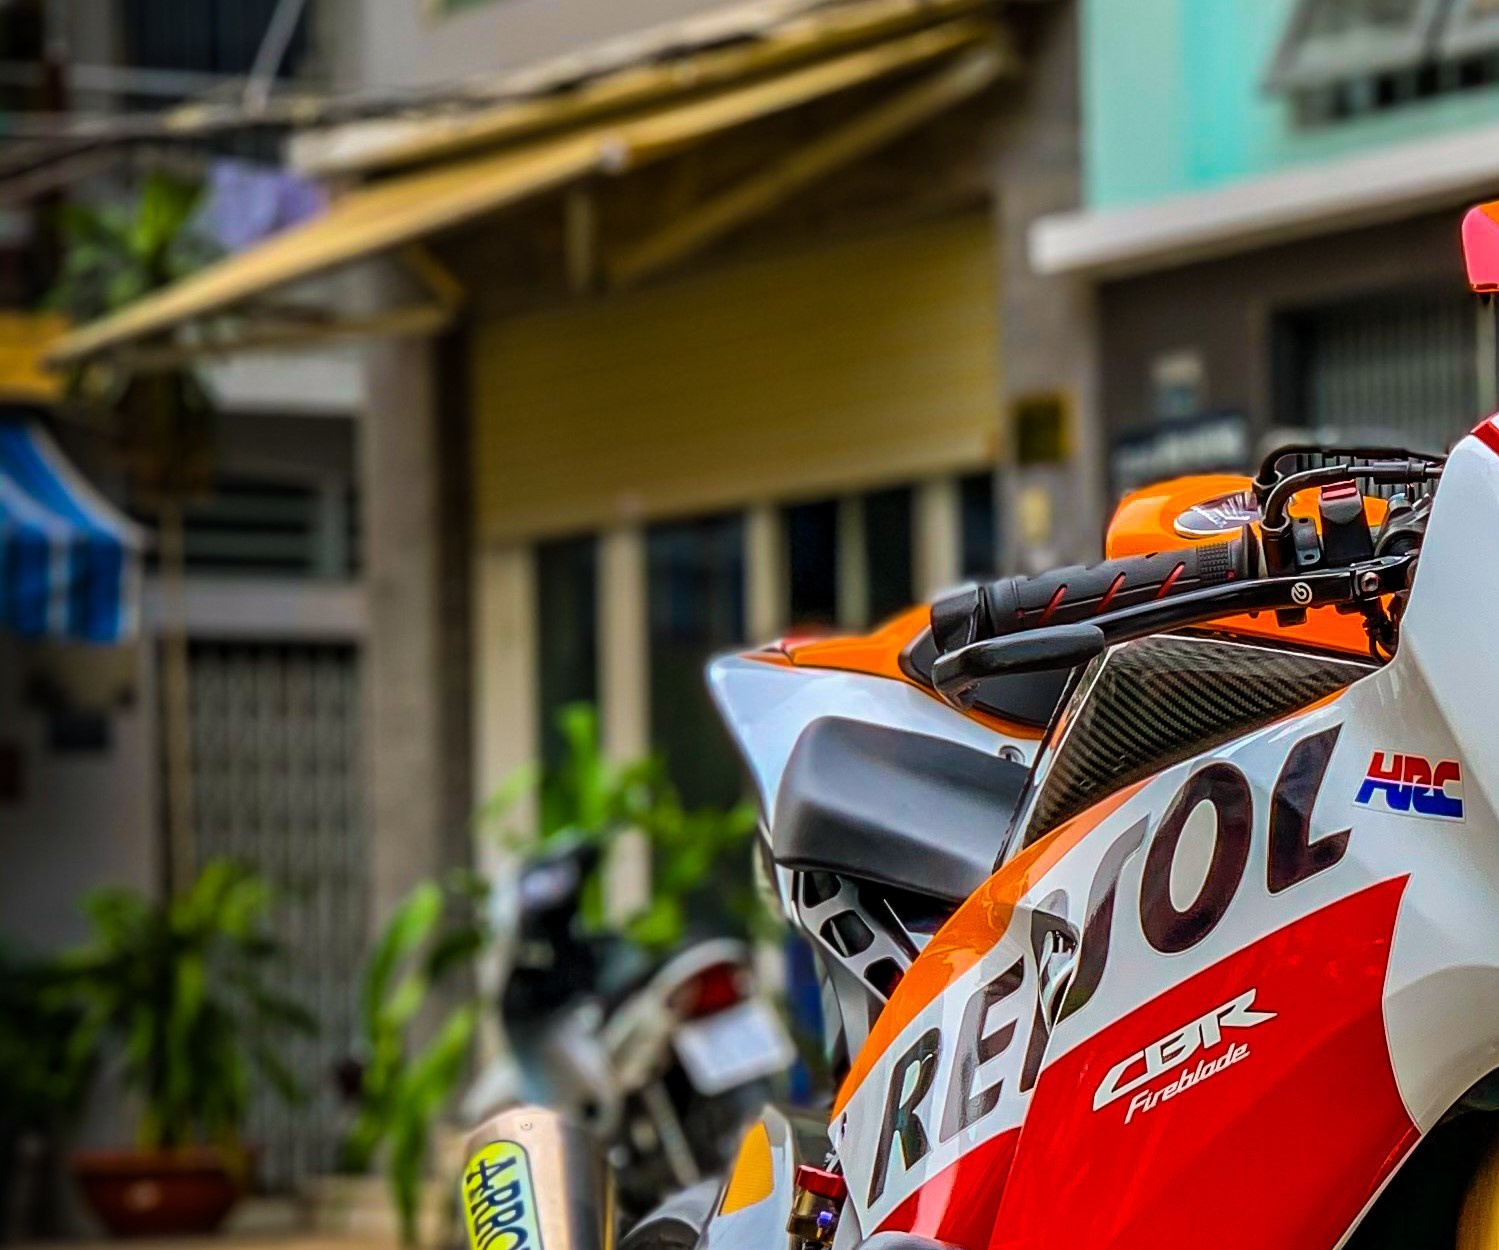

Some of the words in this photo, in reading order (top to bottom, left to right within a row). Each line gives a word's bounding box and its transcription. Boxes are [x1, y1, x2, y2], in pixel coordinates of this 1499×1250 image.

[1354, 750, 1464, 818] HRC
[1093, 988, 1279, 1111] CBR
[1124, 1043, 1250, 1125] Fireblade
